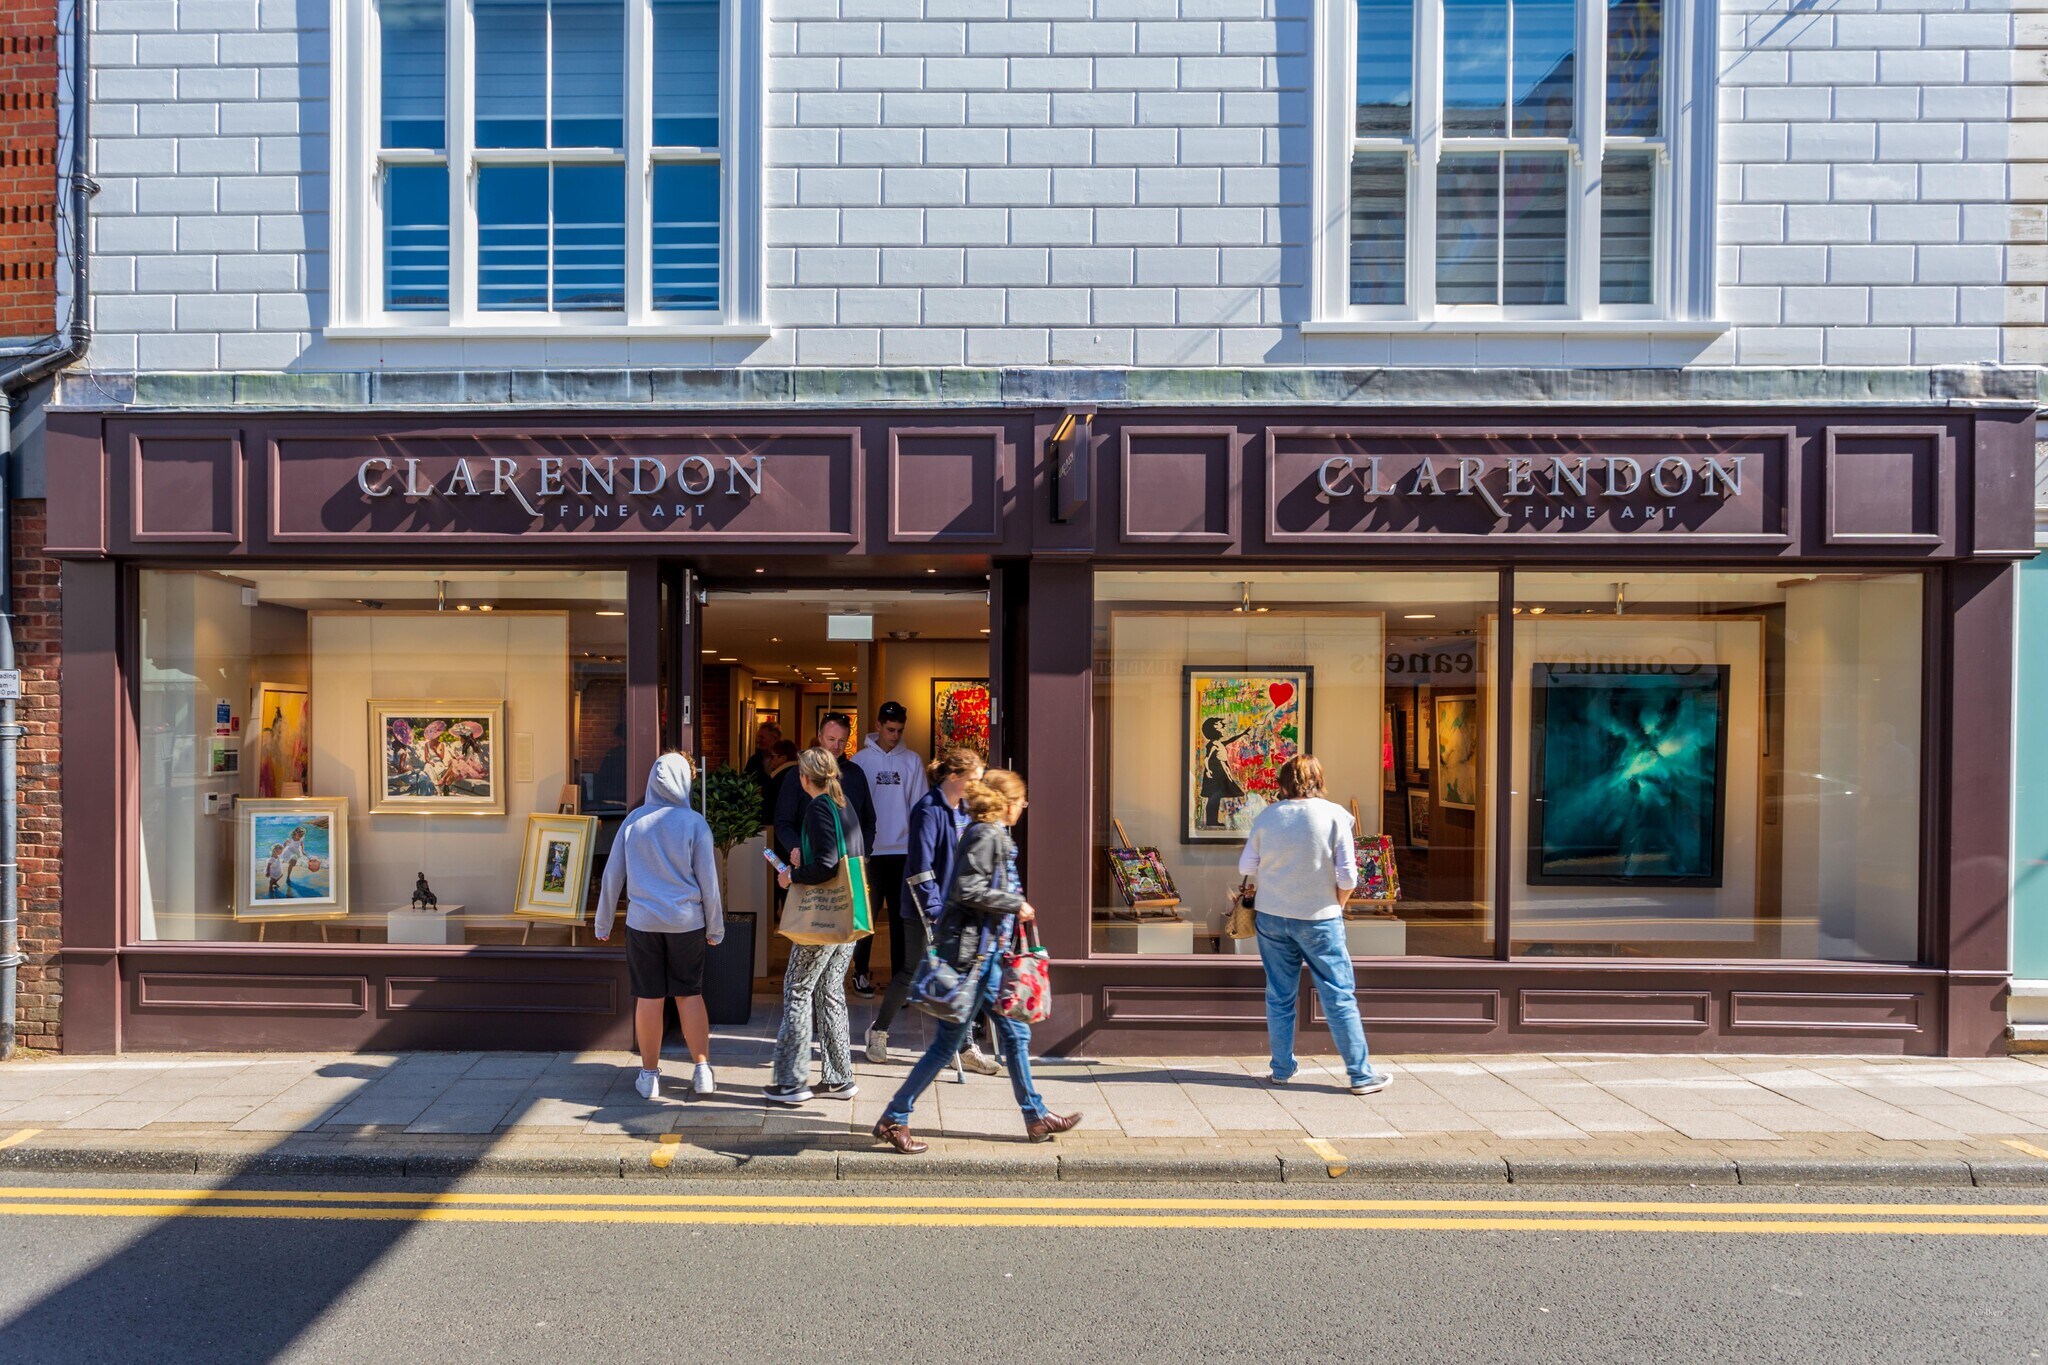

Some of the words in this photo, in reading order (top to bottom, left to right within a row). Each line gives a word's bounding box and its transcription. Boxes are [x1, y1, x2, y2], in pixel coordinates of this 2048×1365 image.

[357, 455, 767, 517] CLARENDON
[1317, 456, 1746, 518] CLARENDON
[560, 504, 628, 517] FINE
[652, 504, 706, 517] ART
[1525, 505, 1595, 518] FINE
[1620, 505, 1677, 518] ART
[1239, 754, 1265, 768] LOVE
[1255, 767, 1277, 778] THE
[1247, 777, 1280, 790] ANSWE
